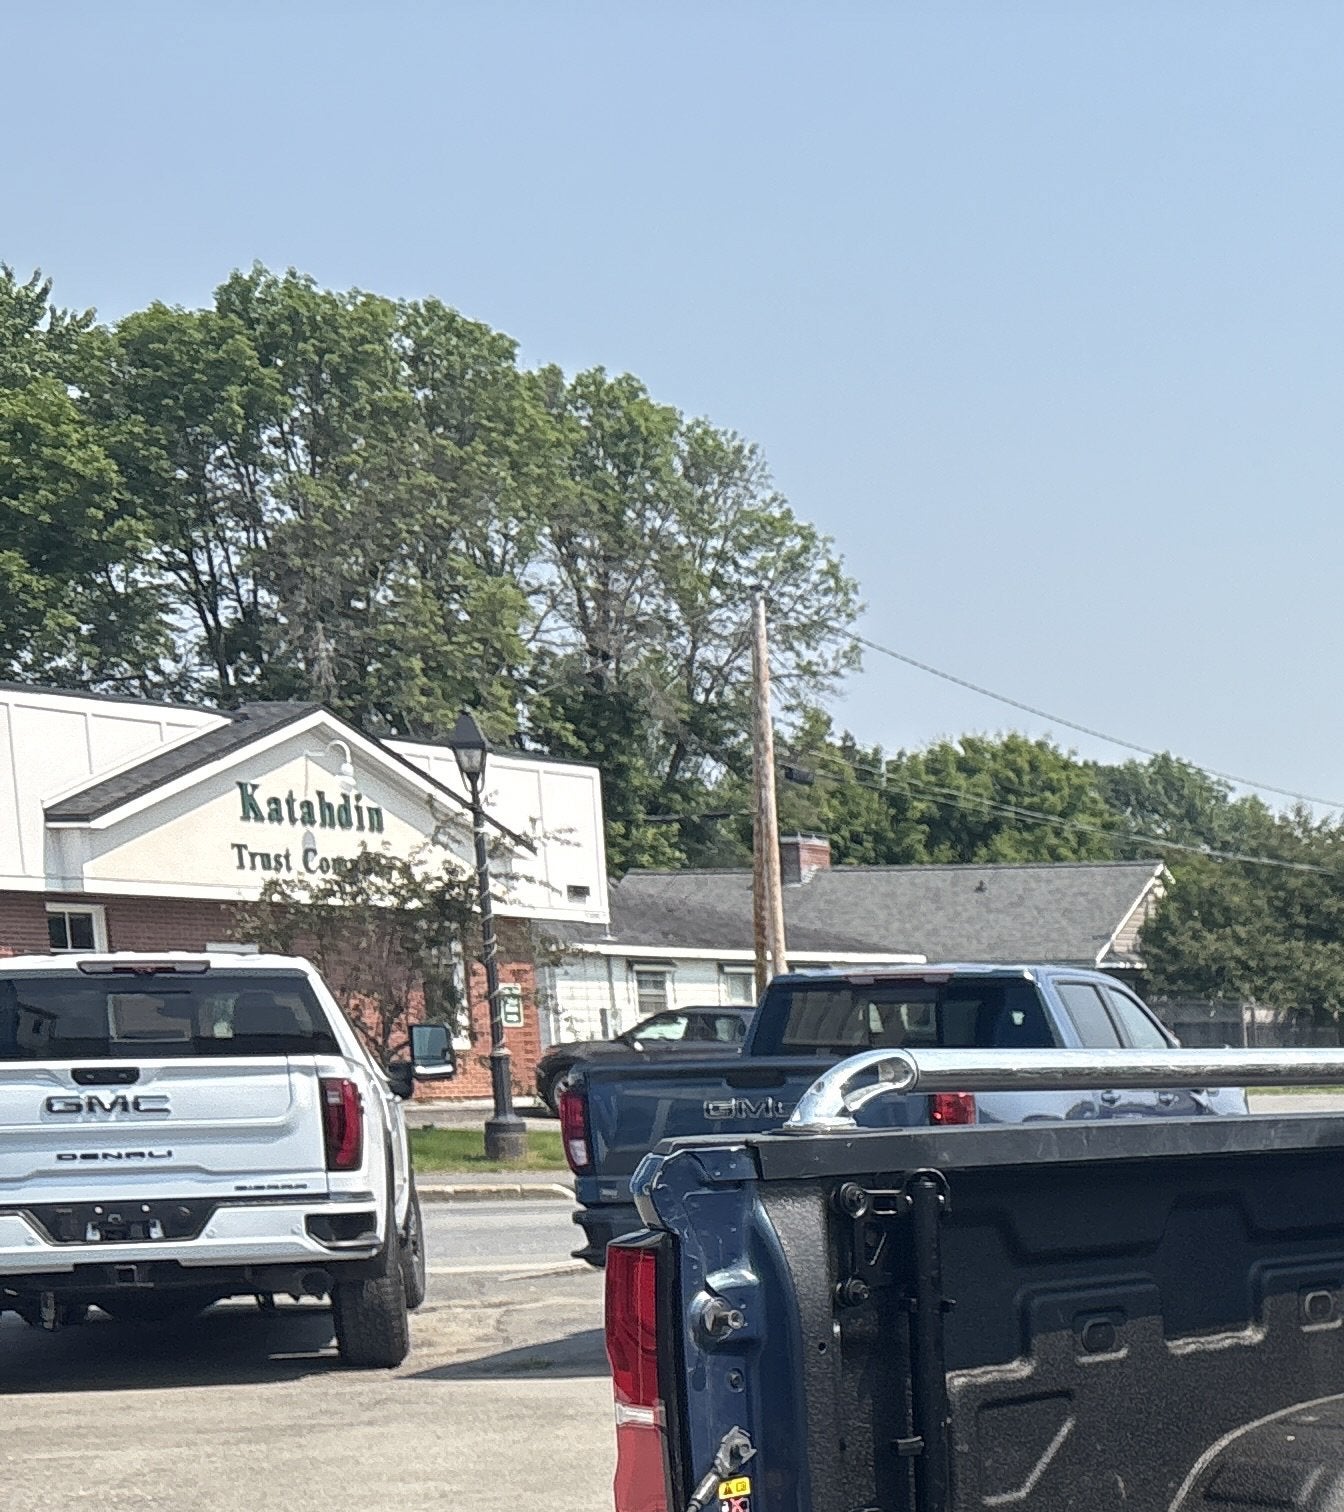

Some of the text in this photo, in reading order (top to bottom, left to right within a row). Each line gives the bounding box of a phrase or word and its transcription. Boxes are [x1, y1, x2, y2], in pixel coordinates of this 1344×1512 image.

[235, 781, 385, 834] Katahdin
[231, 842, 292, 873] Trust
[46, 1094, 172, 1115] GMC
[56, 1149, 173, 1161] DENALI
